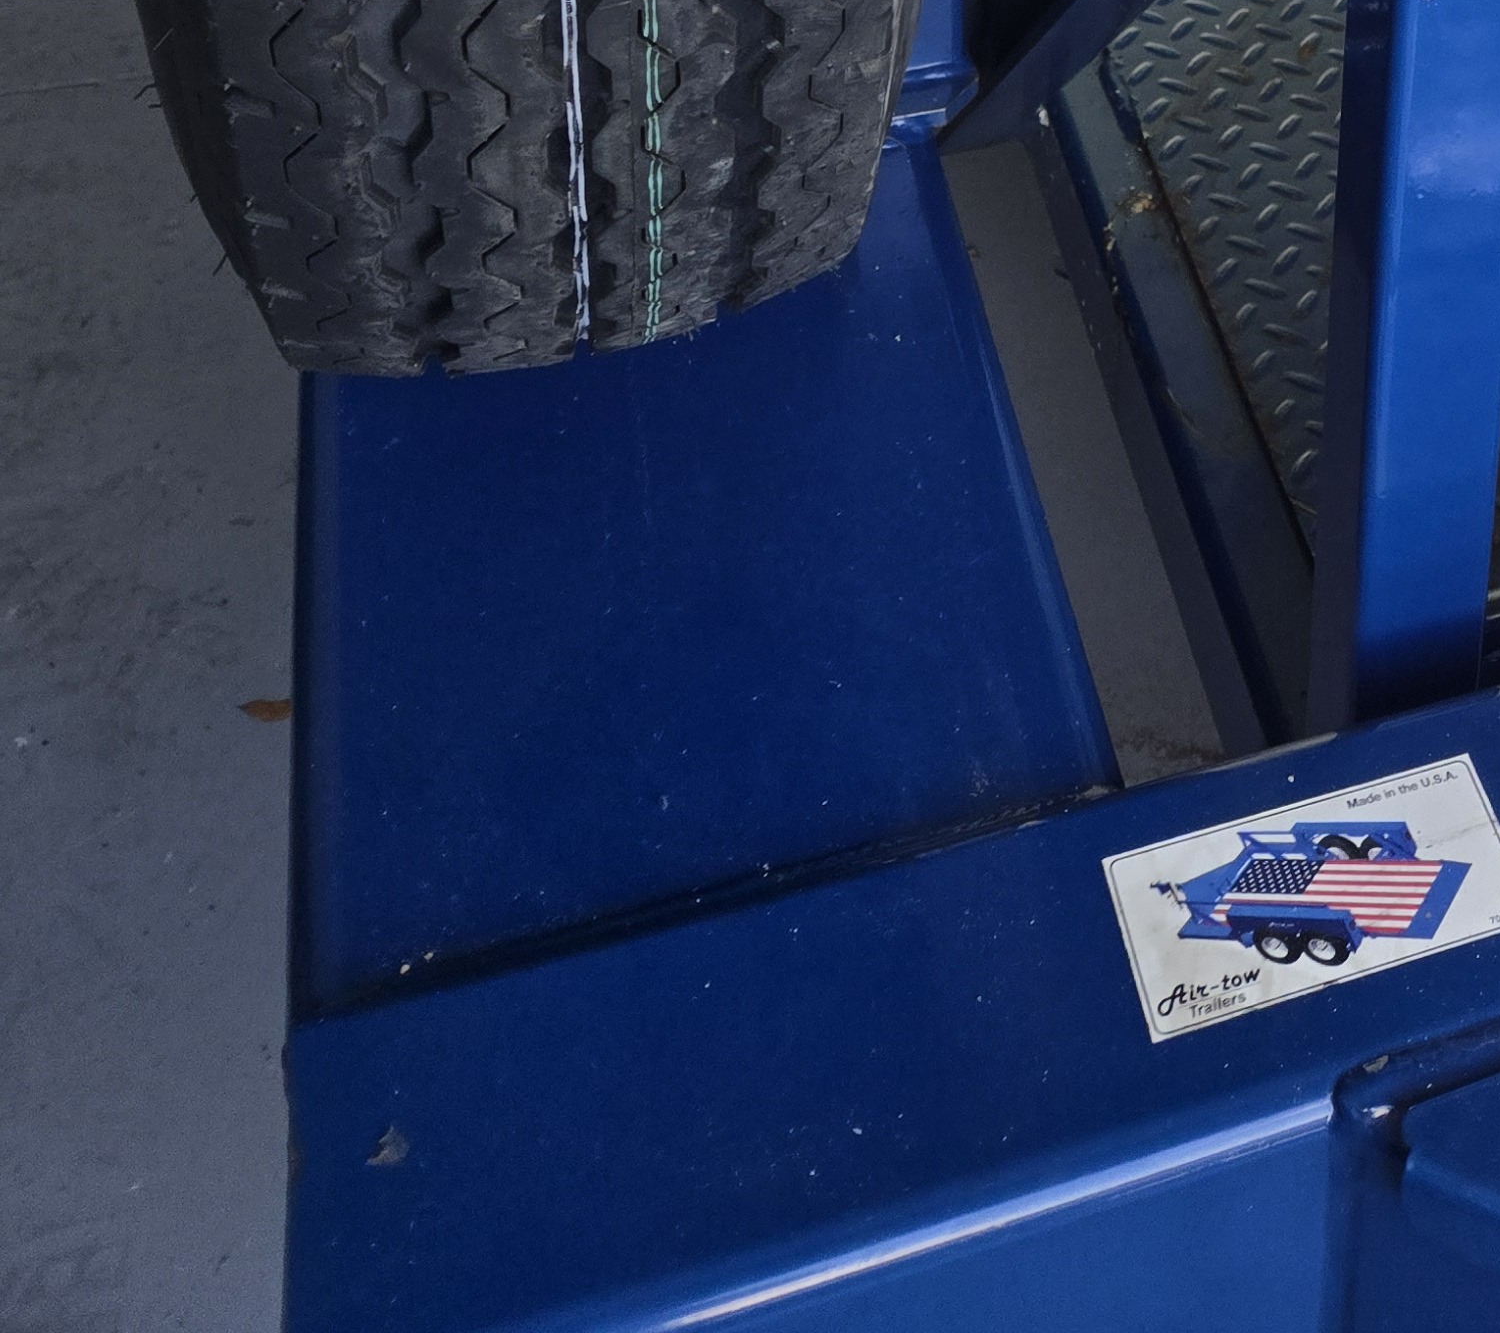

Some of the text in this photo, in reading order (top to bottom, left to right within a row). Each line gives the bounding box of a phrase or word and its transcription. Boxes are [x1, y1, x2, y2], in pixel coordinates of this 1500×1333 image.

[1346, 770, 1459, 810] Made in the U.S.A.
[1157, 968, 1261, 1017] Air-tow
[1188, 992, 1247, 1019] Trailers
